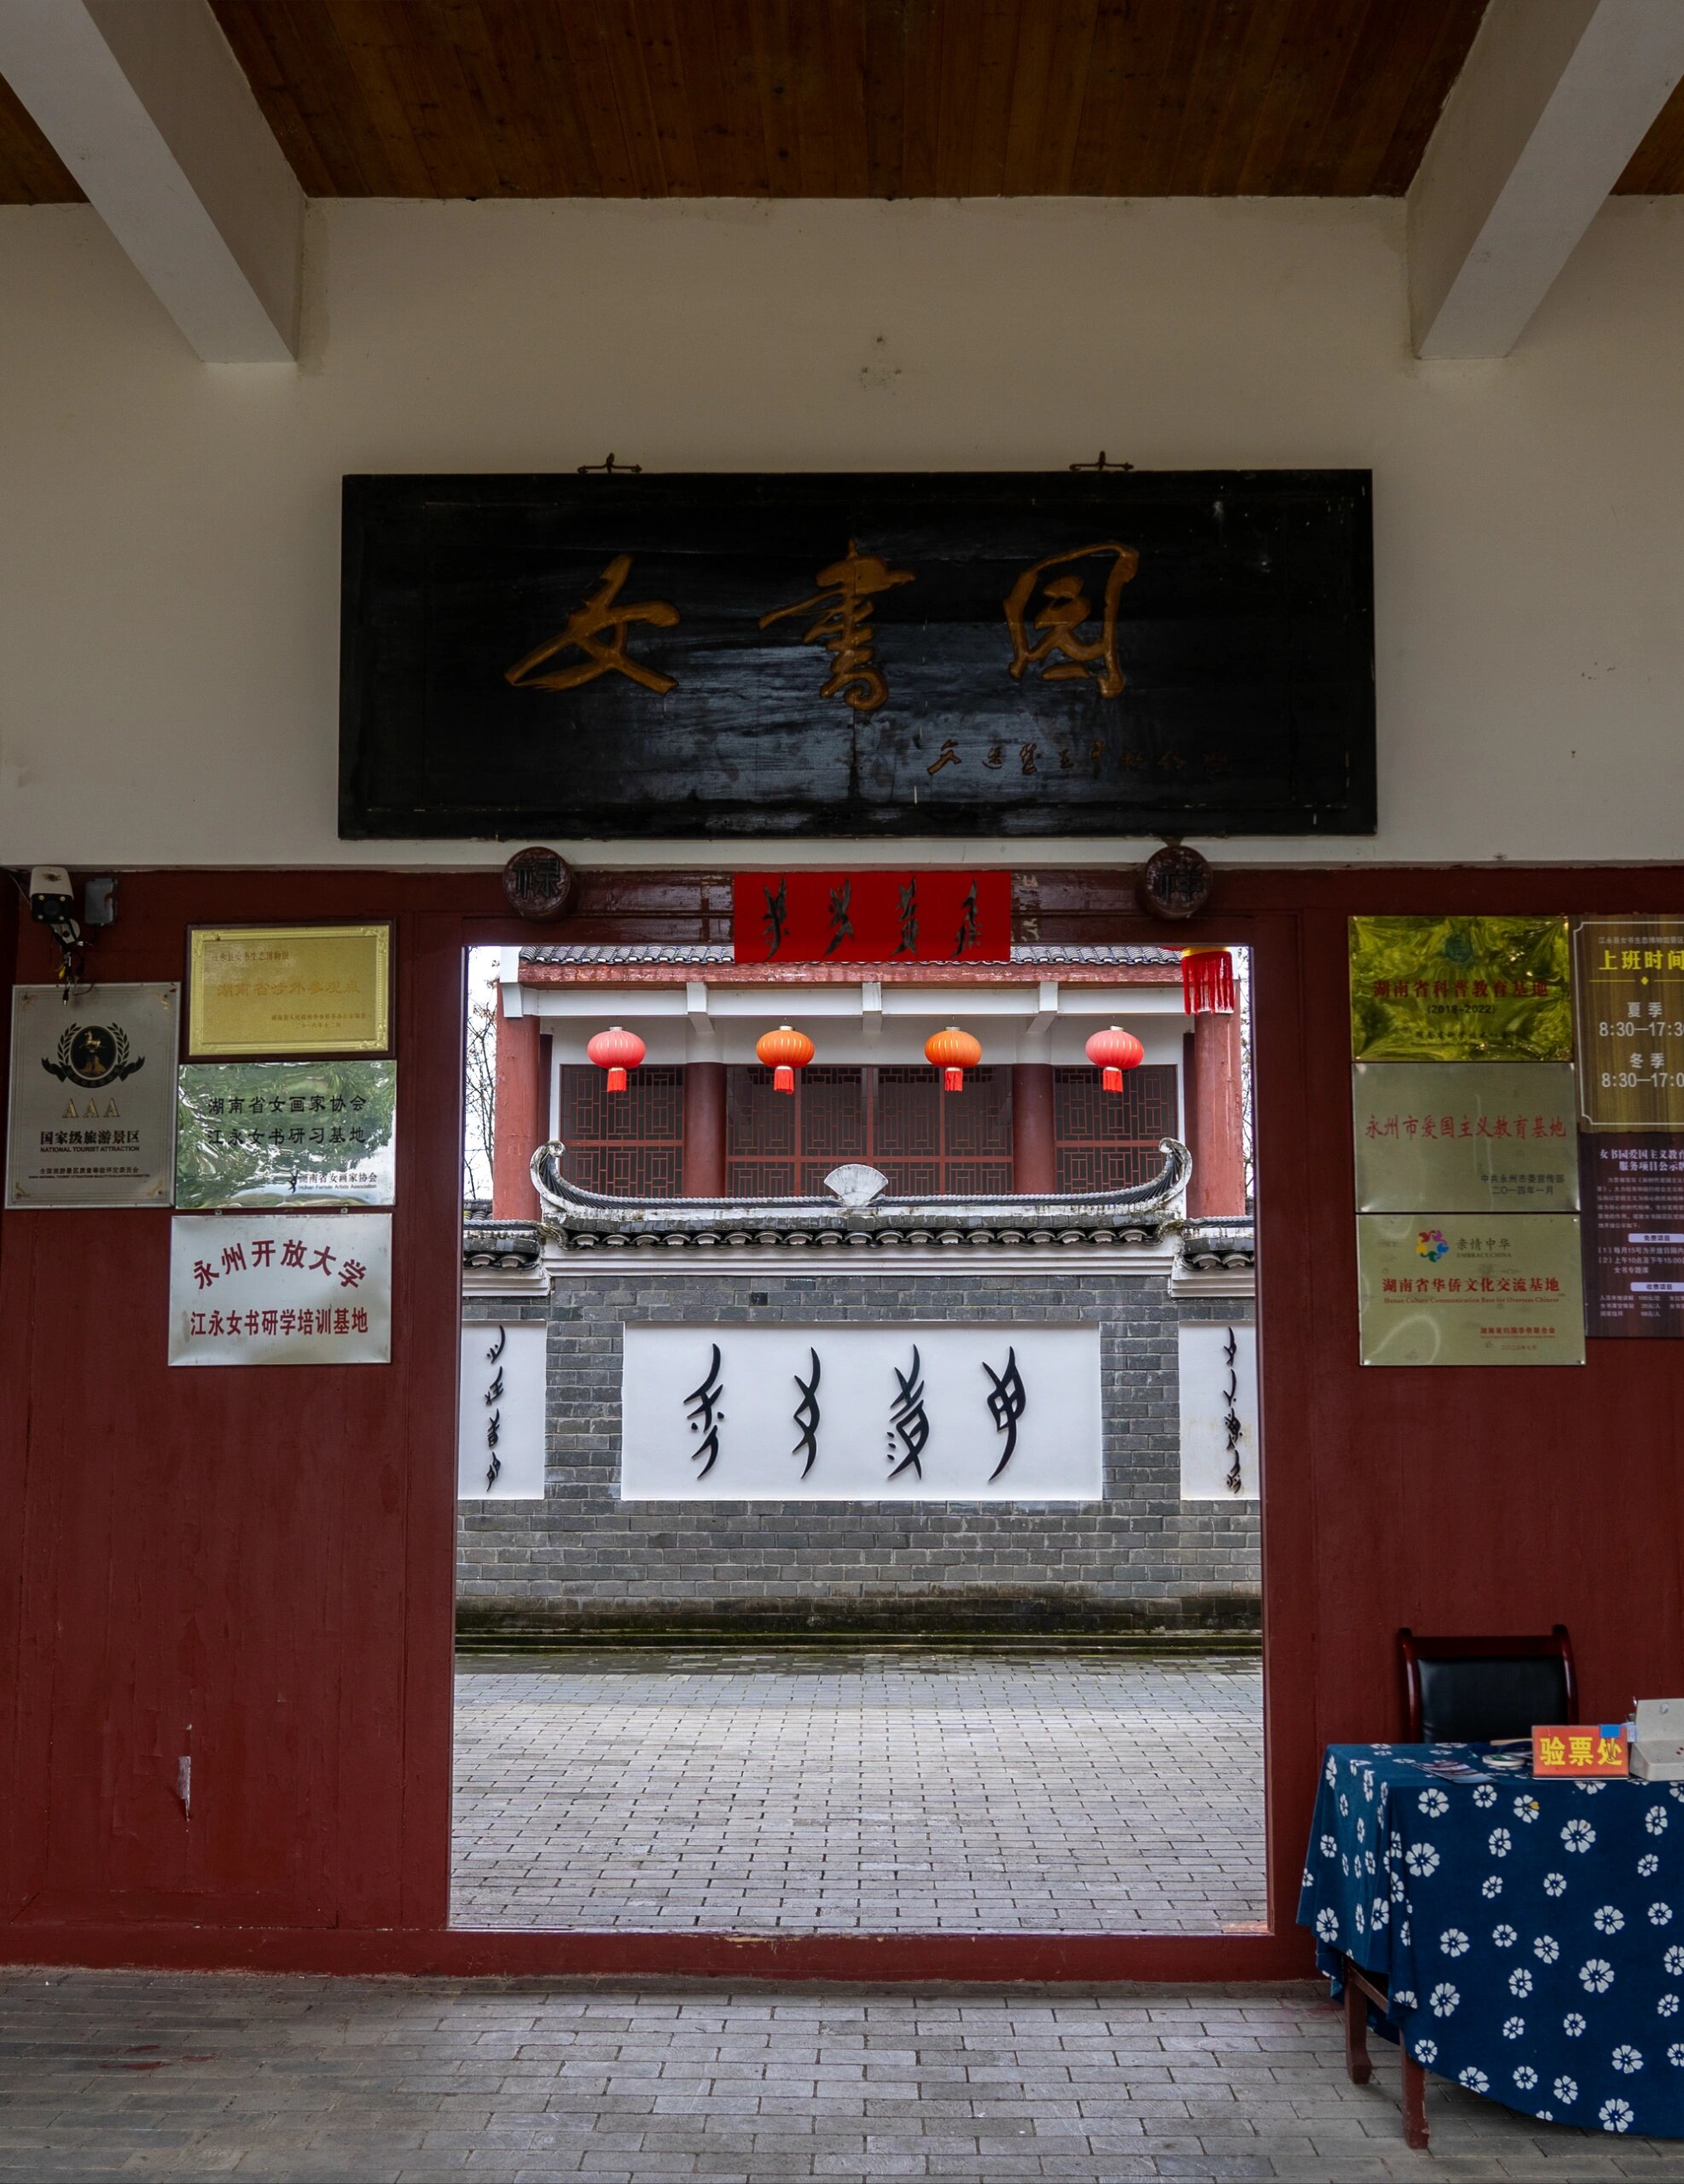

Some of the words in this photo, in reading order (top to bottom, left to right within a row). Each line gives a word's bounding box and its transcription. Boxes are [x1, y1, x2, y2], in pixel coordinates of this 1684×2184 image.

[513, 859, 560, 899] 禄
[1599, 950, 1684, 971] 上班时间
[218, 981, 360, 997] 湖南省涉外参观点
[1373, 979, 1548, 997] 湖南省科普教育基地
[208, 1095, 367, 1114] 湖南省女画家协会
[207, 1126, 366, 1146] 江永女书研习基地
[1365, 1113, 1566, 1141] 永州市爱国主义教育基地
[40, 1130, 140, 1145] 国家级旅游景区
[299, 1172, 377, 1183] 湖南省女画家协会
[1481, 1174, 1565, 1184] 中共永州市委宣传部
[1455, 1237, 1512, 1251] 亲情中华
[193, 1239, 367, 1289] 永州开放大学
[1383, 1277, 1559, 1292] 湖南省华侨文化交流基地
[190, 1307, 369, 1336] 江永女书研学培训基地
[1540, 1736, 1623, 1767] 验票处
